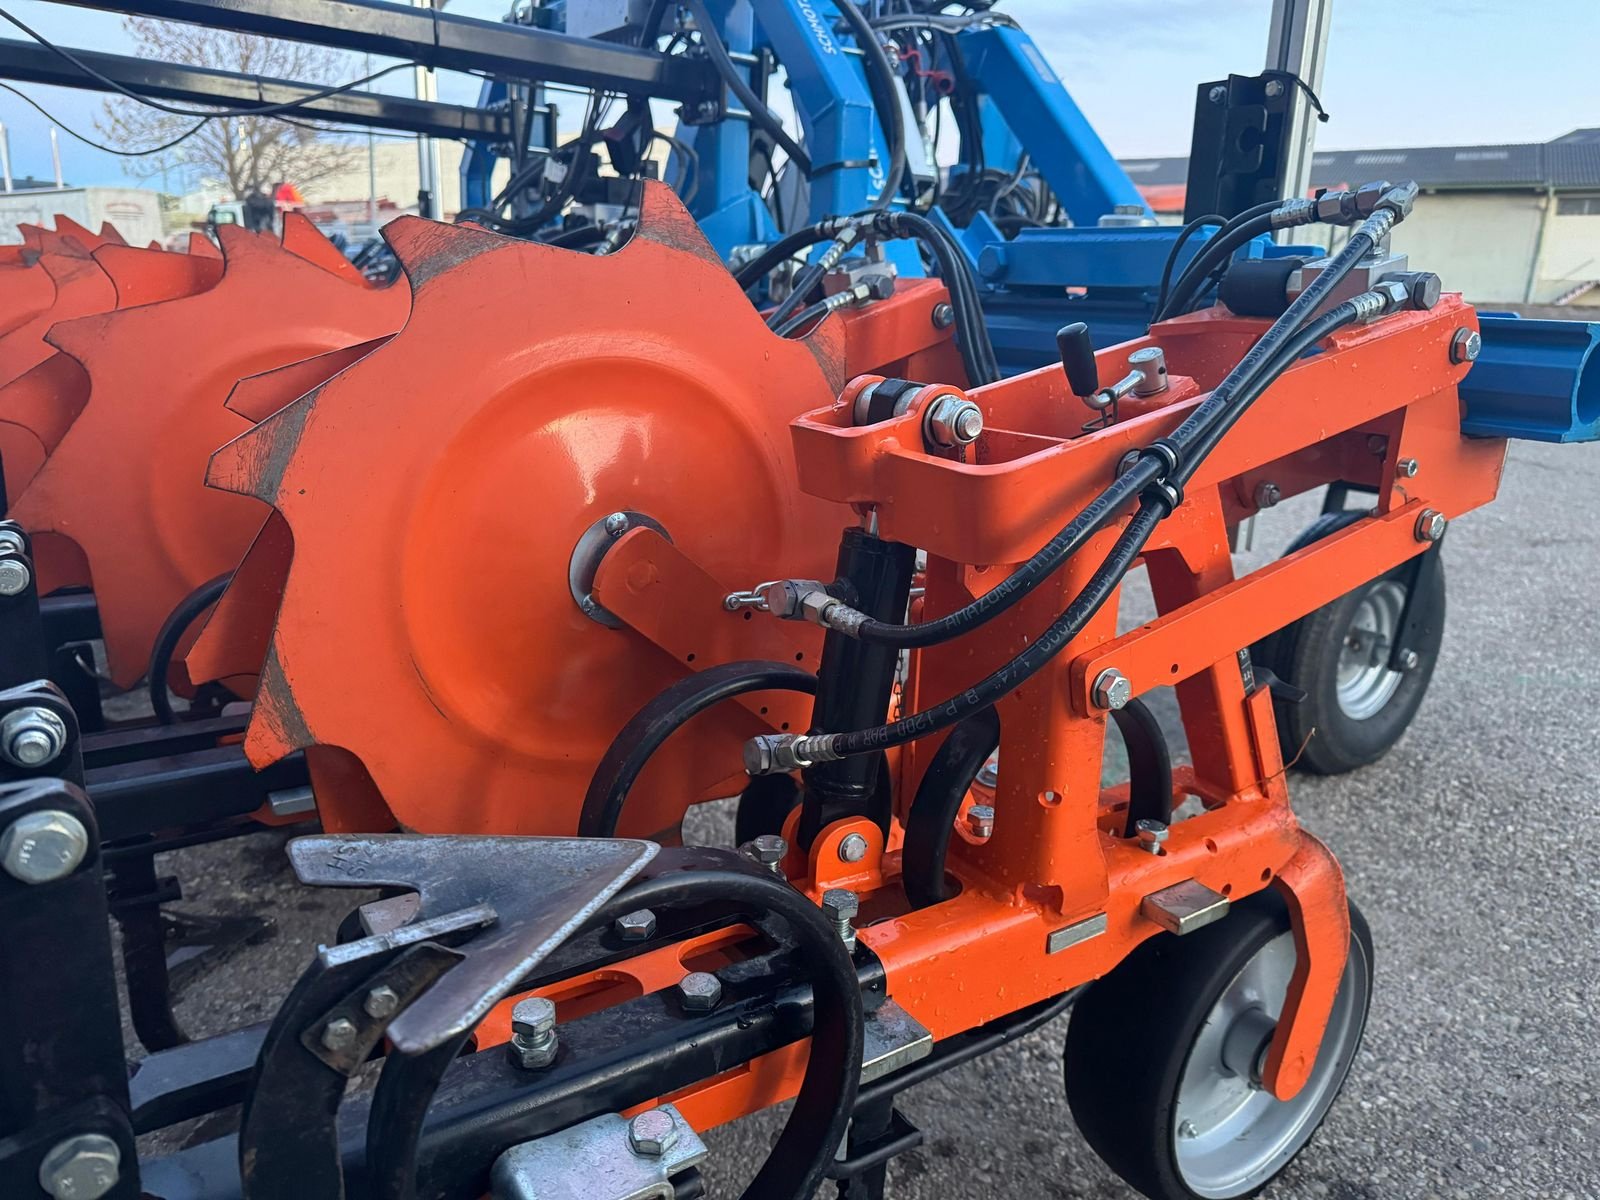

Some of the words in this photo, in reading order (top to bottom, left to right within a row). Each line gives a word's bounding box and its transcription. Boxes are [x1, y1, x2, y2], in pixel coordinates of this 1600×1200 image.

[797, 0, 837, 55] SCHMOT
[945, 576, 1022, 631] AMAZONE
[863, 726, 889, 746] BAR
[896, 710, 935, 736] 1200
